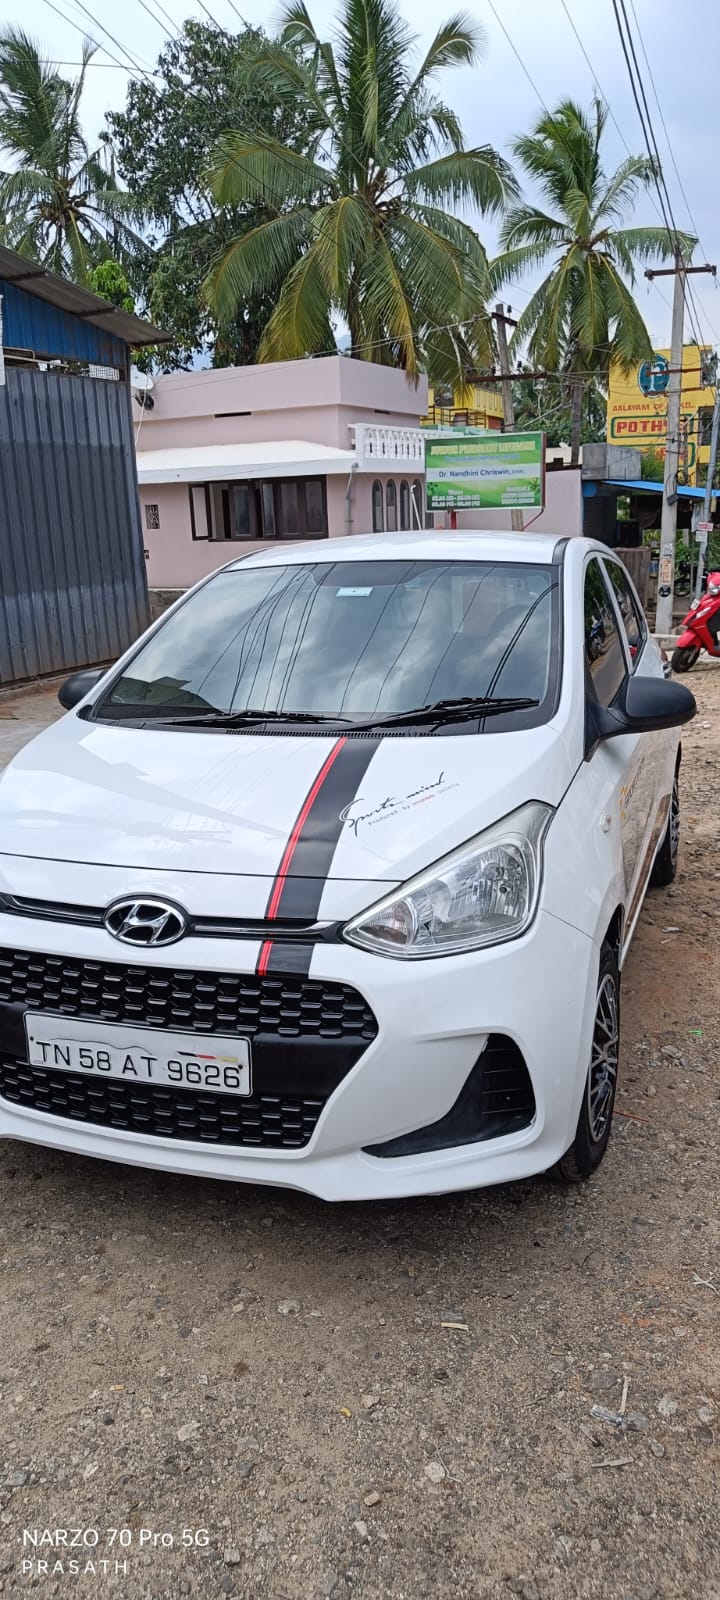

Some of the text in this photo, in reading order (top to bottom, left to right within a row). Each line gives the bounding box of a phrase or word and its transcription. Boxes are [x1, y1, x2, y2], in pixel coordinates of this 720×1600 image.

[612, 403, 650, 412] AALAYAM
[449, 469, 479, 478] Nandhini
[35, 1041, 240, 1088] TN 58 AT 9626
